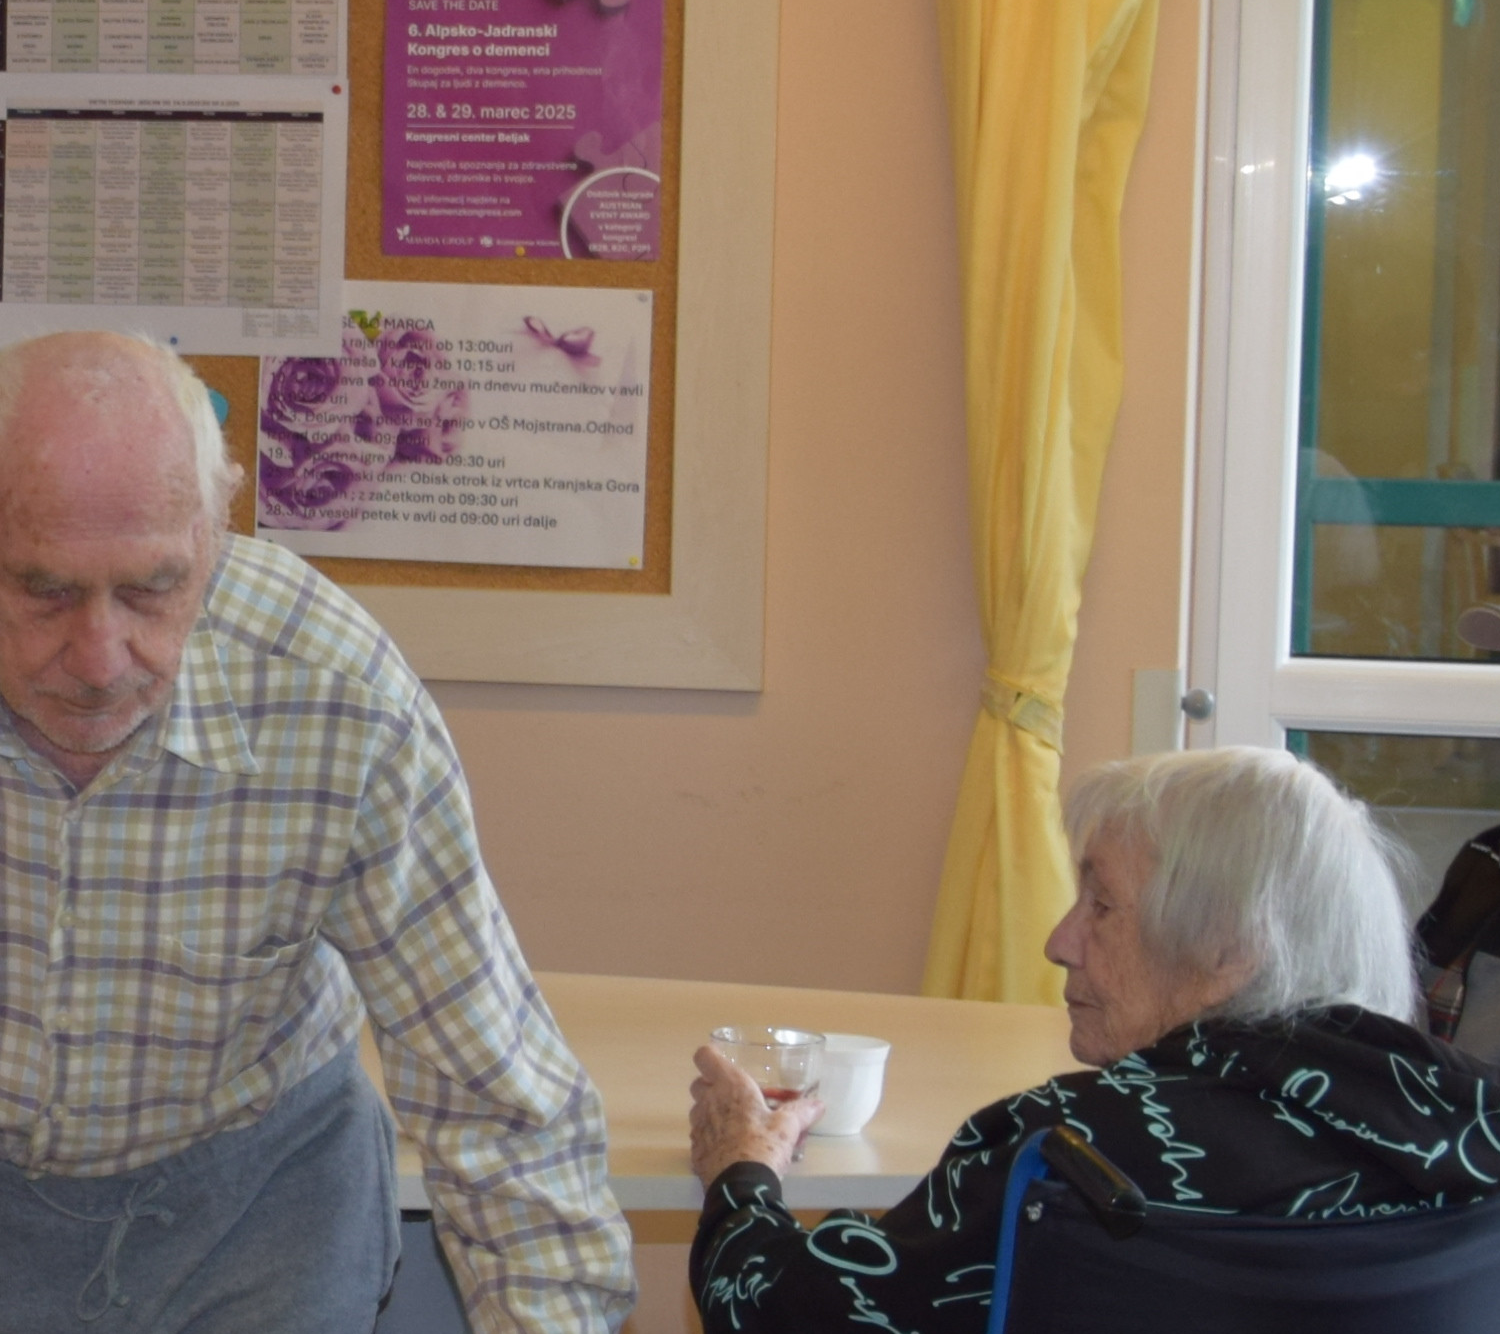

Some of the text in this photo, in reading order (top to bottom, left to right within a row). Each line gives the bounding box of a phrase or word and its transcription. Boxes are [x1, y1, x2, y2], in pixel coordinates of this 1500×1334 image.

[409, 0, 498, 11] SAVE THE DATE
[408, 24, 557, 40] 6. Alpsko-Jadranski
[408, 43, 549, 59] Kongres o demenci
[408, 104, 576, 119] 28. & 29. marec 2025
[406, 132, 530, 144] Kongresni center Beljak
[384, 318, 435, 331] MARCA
[436, 340, 453, 352] ob
[459, 341, 513, 353] 13:00uri
[340, 357, 376, 368] maša
[434, 360, 452, 371] ob
[457, 360, 493, 371] 10:15
[497, 361, 514, 372] uri
[432, 378, 465, 391] žena
[468, 379, 480, 390] in
[484, 380, 526, 392] dnevu
[530, 382, 605, 394] mučenikov
[609, 387, 616, 395] v
[620, 384, 643, 396] avli
[330, 394, 347, 404] uri
[305, 413, 372, 424] Delavni
[479, 421, 486, 429] v
[489, 416, 509, 430] OŠ
[513, 419, 634, 435] Mojstrana.Odhod
[312, 432, 350, 442] doma
[360, 451, 384, 465] igre
[446, 456, 484, 467] 09:30
[488, 458, 505, 468] uri
[377, 469, 639, 493] dan: Obisk otrok iz vrtca Kranjska Gora
[369, 489, 434, 504] začetkom
[438, 494, 455, 504] ob
[459, 494, 497, 506] 09:30
[501, 495, 518, 507] uri
[320, 507, 358, 519] veseli
[362, 508, 398, 521] petek
[403, 512, 410, 520] v
[413, 509, 436, 522] avli
[439, 512, 456, 524] od
[460, 513, 498, 526] 09:00
[502, 515, 519, 526] uri
[523, 515, 557, 530] dalje
